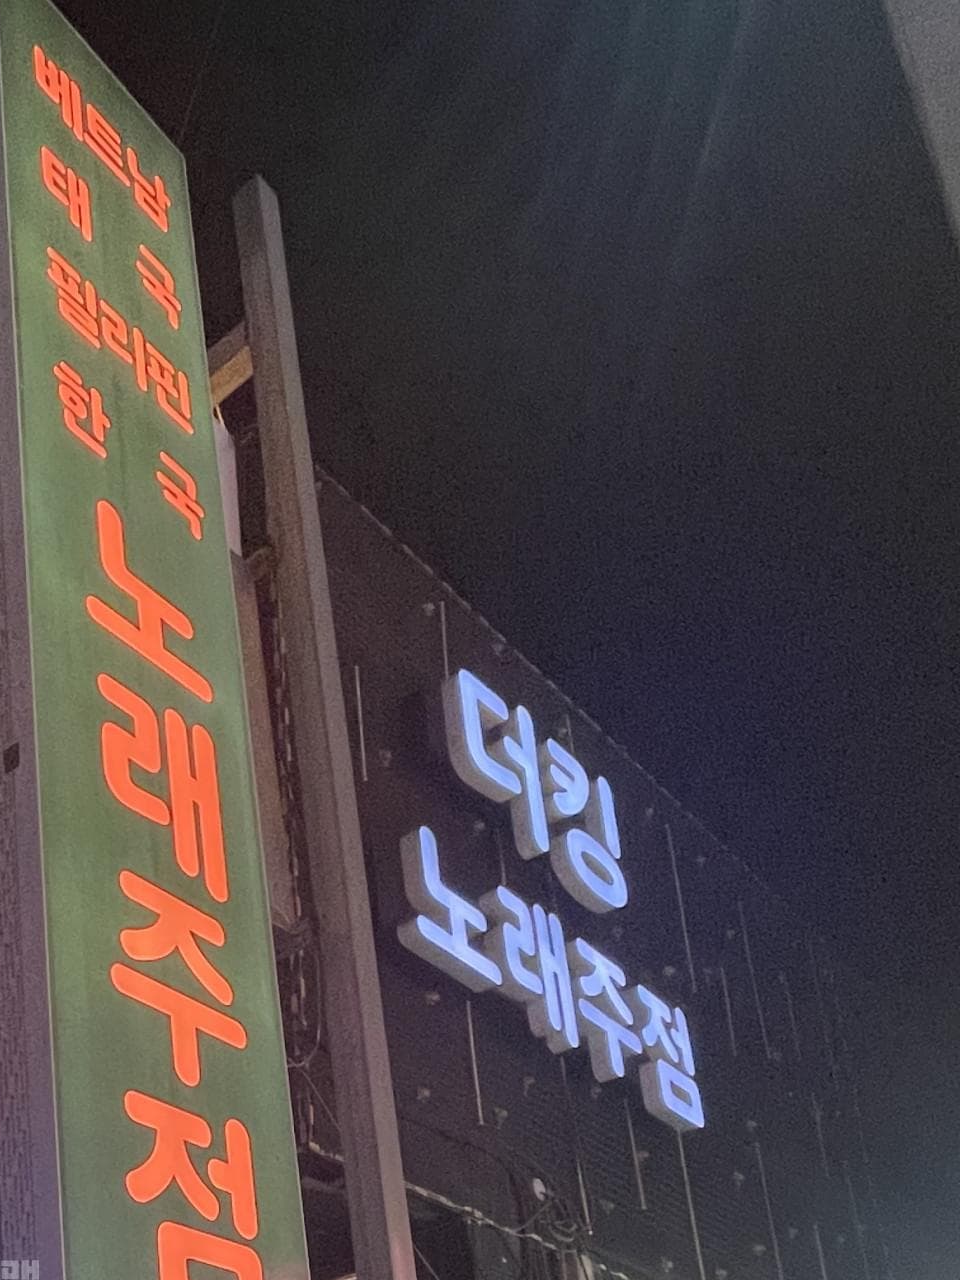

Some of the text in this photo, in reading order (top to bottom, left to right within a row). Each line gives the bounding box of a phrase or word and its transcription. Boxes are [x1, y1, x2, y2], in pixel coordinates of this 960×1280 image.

[32, 43, 171, 234] 베트남
[46, 246, 195, 436] 필리핀
[446, 667, 629, 914] 더킹
[402, 825, 706, 1130] 노래주점
